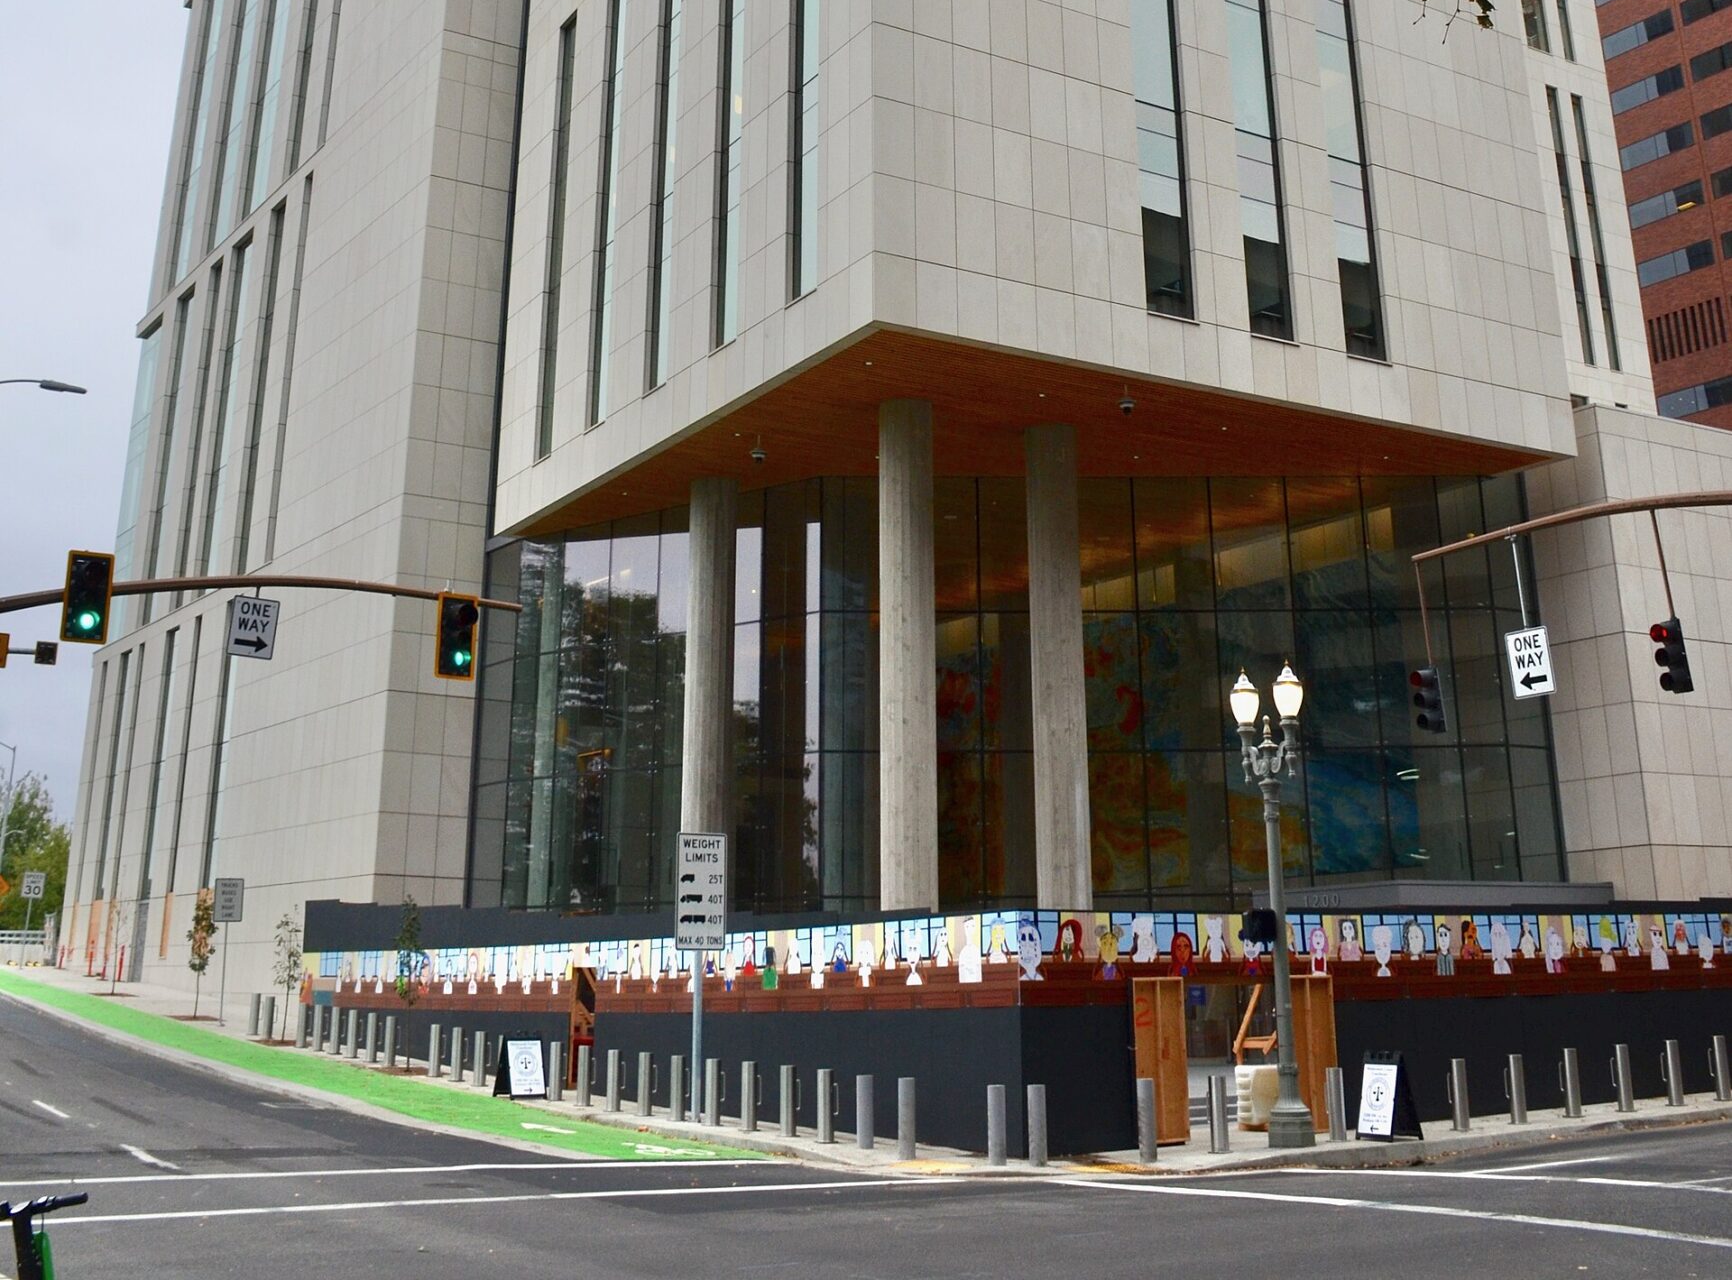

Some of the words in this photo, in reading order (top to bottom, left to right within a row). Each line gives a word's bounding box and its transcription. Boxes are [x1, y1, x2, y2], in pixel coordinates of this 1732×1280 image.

[241, 601, 271, 618] ONE
[238, 617, 270, 633] WAY
[1514, 634, 1541, 652] ONE
[1515, 651, 1543, 669] WAY
[683, 839, 720, 849] WEIGHT
[685, 853, 719, 863] LIMITS
[708, 874, 723, 884] 25T
[23, 885, 41, 896] 30
[707, 894, 723, 904] 40T
[1304, 894, 1339, 908] 1200
[707, 915, 723, 925] 40T
[678, 936, 692, 945] MAX
[695, 936, 704, 945] 40
[706, 936, 723, 945] TONS
